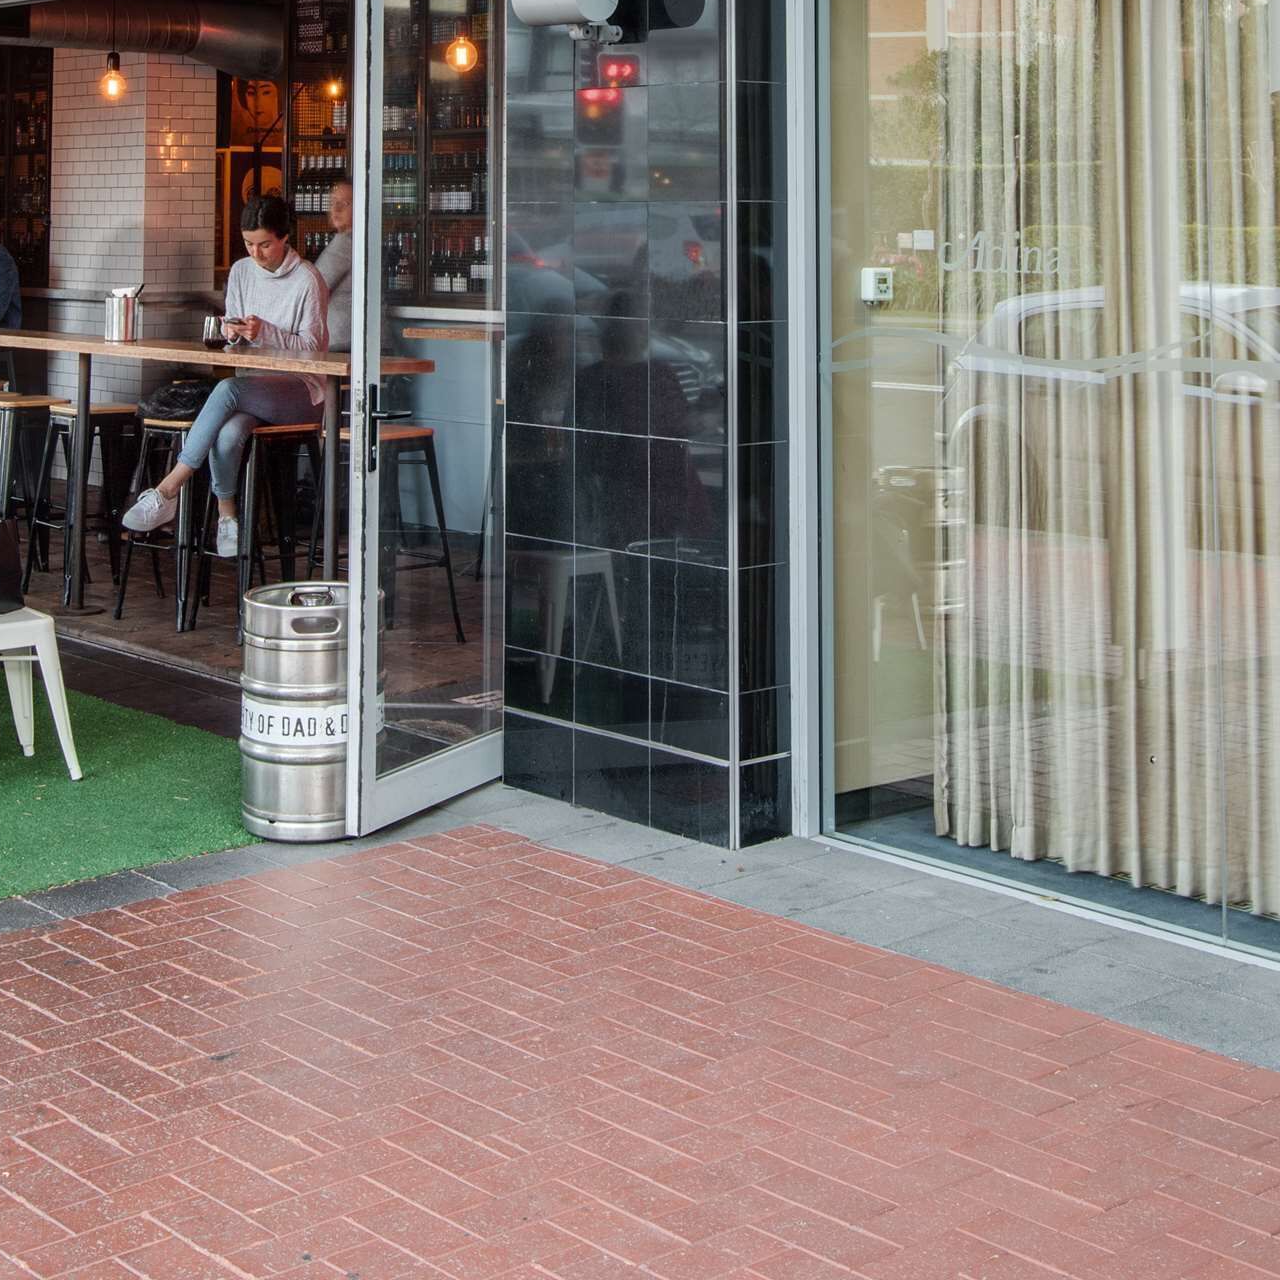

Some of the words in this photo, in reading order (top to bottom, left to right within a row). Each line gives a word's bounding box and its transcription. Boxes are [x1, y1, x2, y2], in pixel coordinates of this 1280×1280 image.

[939, 230, 1066, 274] Adina
[257, 713, 275, 736] OF
[282, 716, 317, 737] DAD
[325, 716, 337, 736] &
